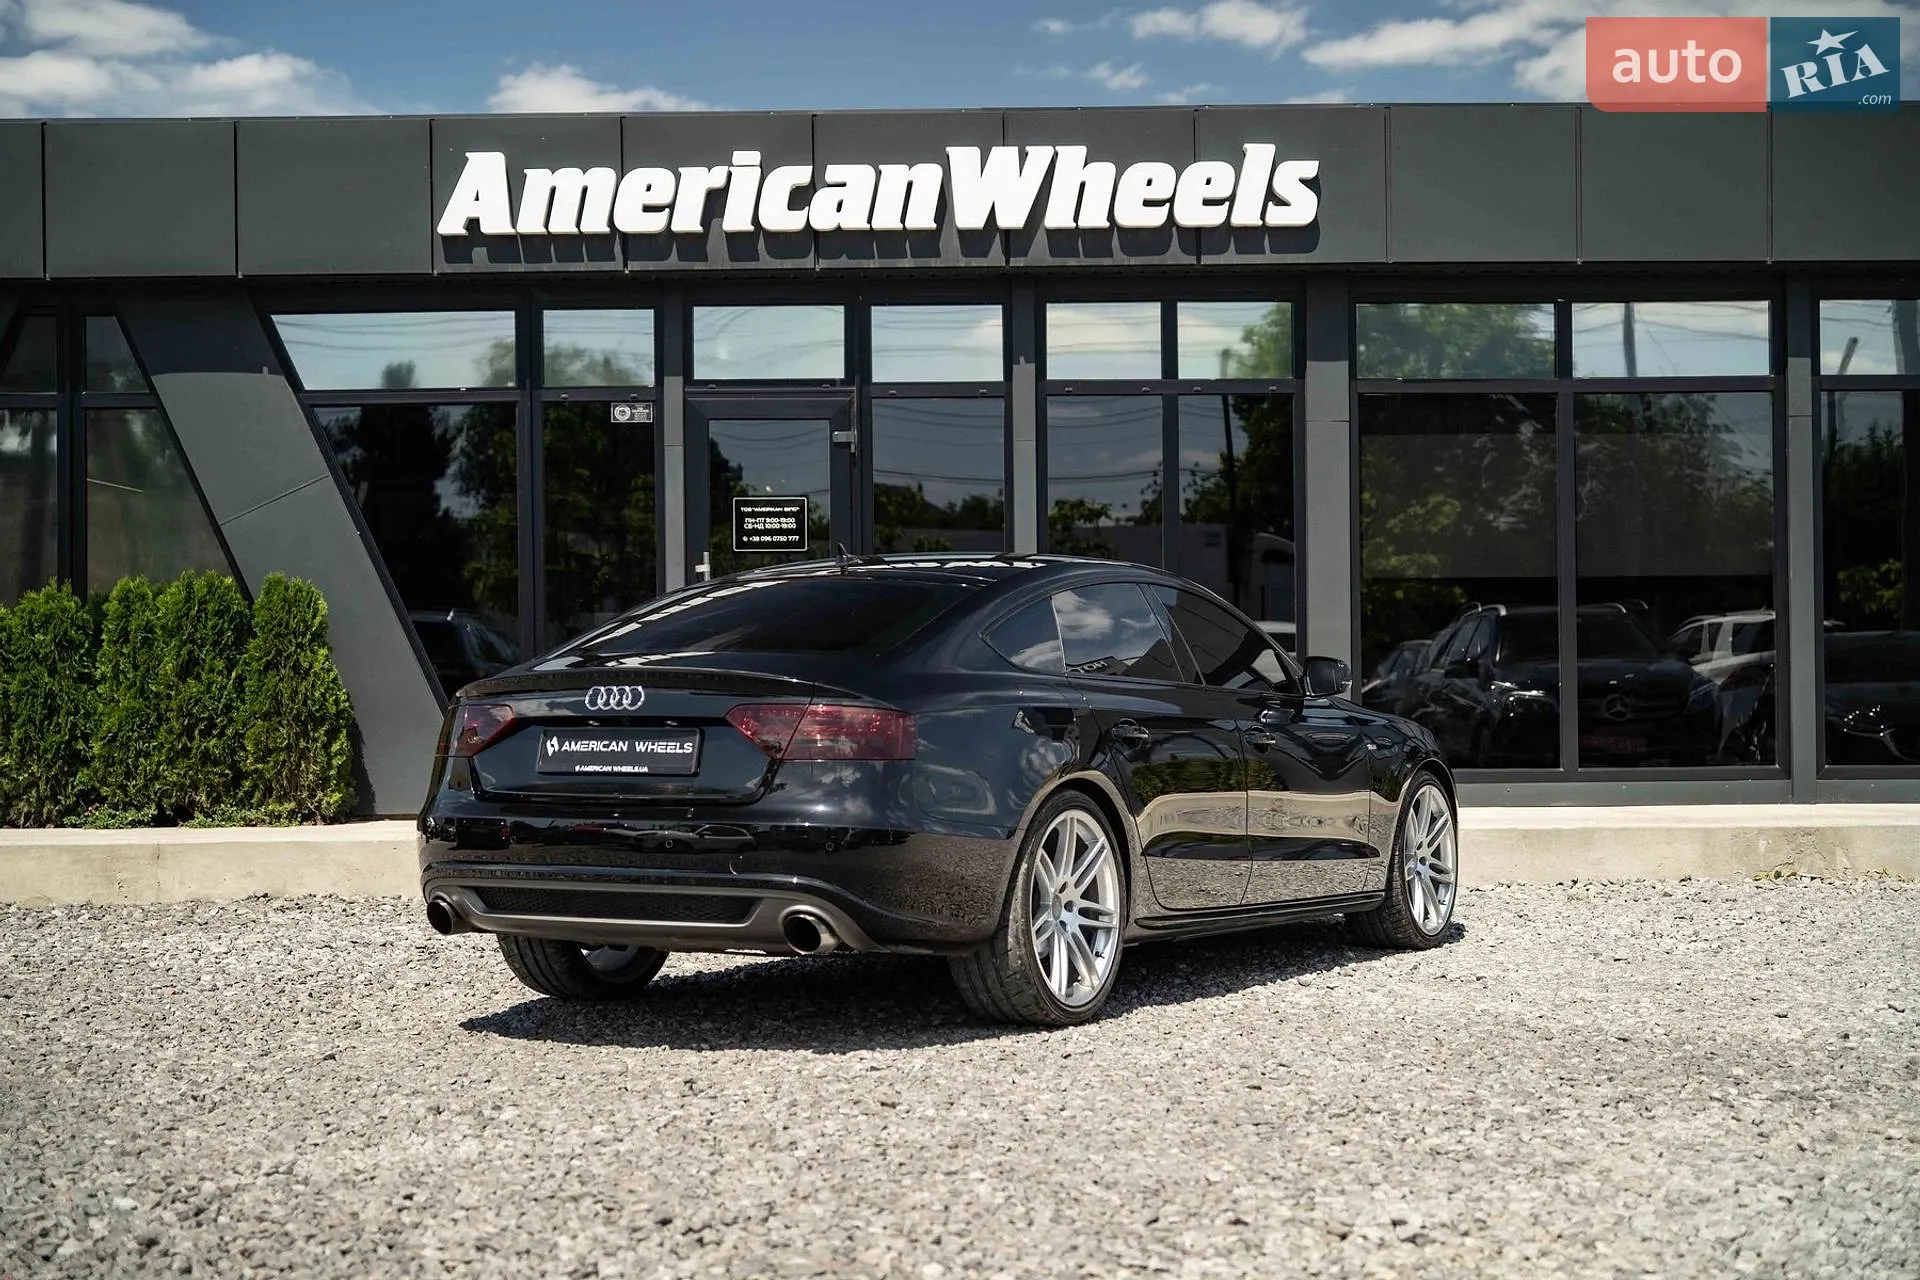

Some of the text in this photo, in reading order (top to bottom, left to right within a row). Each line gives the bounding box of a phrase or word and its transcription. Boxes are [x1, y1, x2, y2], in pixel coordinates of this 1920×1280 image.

[436, 143, 1321, 236] AmericanWheels
[560, 741, 694, 754] AMERICAN WHEELS
